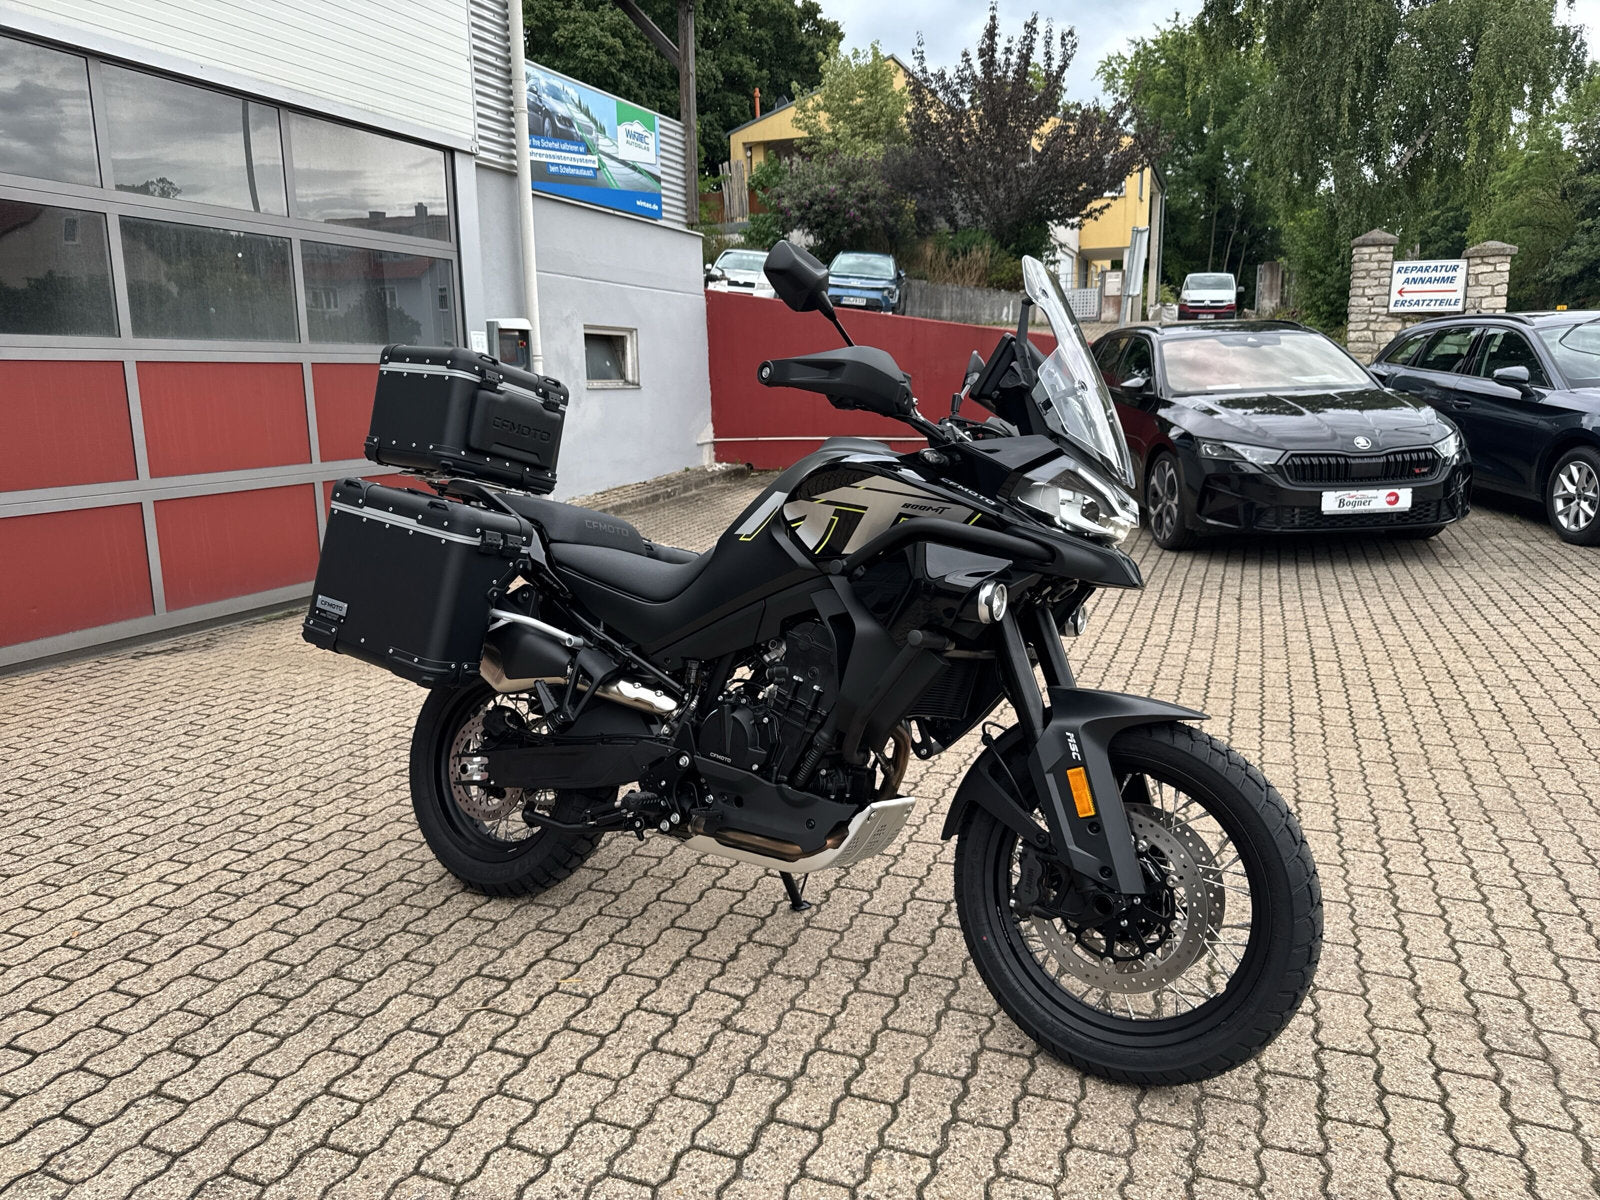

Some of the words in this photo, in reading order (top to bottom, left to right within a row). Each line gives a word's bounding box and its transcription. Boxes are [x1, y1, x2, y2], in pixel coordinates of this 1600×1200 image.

[541, 139, 560, 149] Sicherheit
[626, 140, 650, 152] AUTOGLAS
[636, 199, 659, 211] wintec.de
[1396, 264, 1464, 274] REPARATUR-
[1402, 276, 1457, 285] ANNAHME
[1393, 298, 1460, 307] ERSATZTEILE
[492, 416, 551, 442] CFMOTO
[940, 477, 997, 506] CFMOTO
[901, 502, 952, 515] 800MT
[1338, 497, 1372, 508] Bogner
[584, 519, 630, 537] CFMOTO
[320, 599, 344, 612] CFMOTO
[1065, 731, 1082, 761] MSC
[709, 751, 732, 763] CFMOTO
